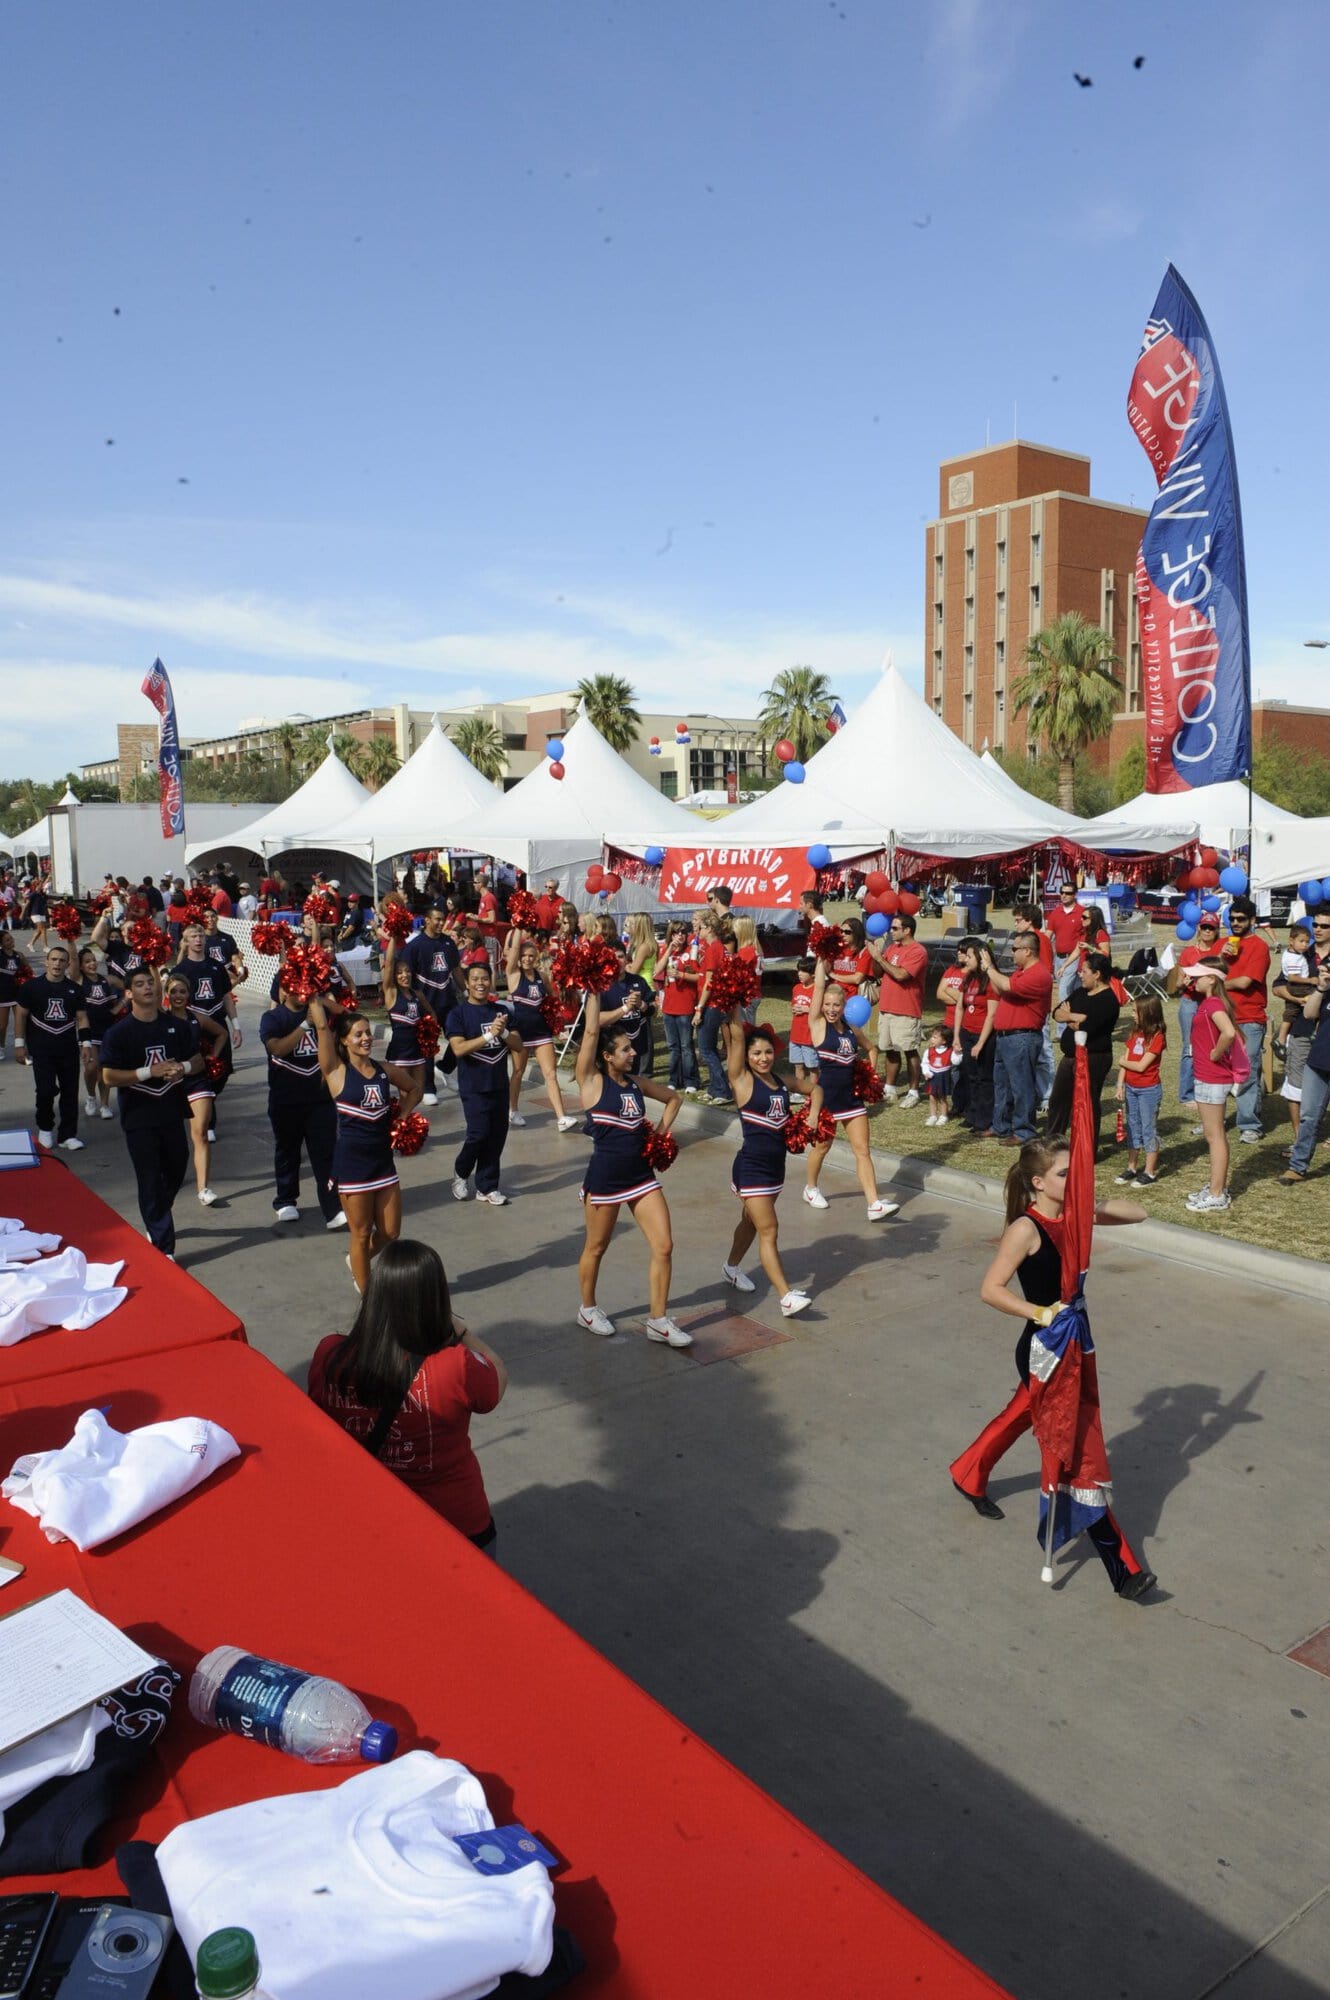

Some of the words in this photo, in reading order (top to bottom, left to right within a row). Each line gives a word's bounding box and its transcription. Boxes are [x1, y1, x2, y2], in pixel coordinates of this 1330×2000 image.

[664, 848, 714, 902] HAPPY
[717, 848, 792, 904] BIRTHDAY
[432, 952, 448, 972] A
[195, 977, 215, 1000] A
[44, 998, 68, 1021] A
[360, 1084, 385, 1109] A
[620, 1093, 644, 1118] A
[765, 1095, 788, 1120] A
